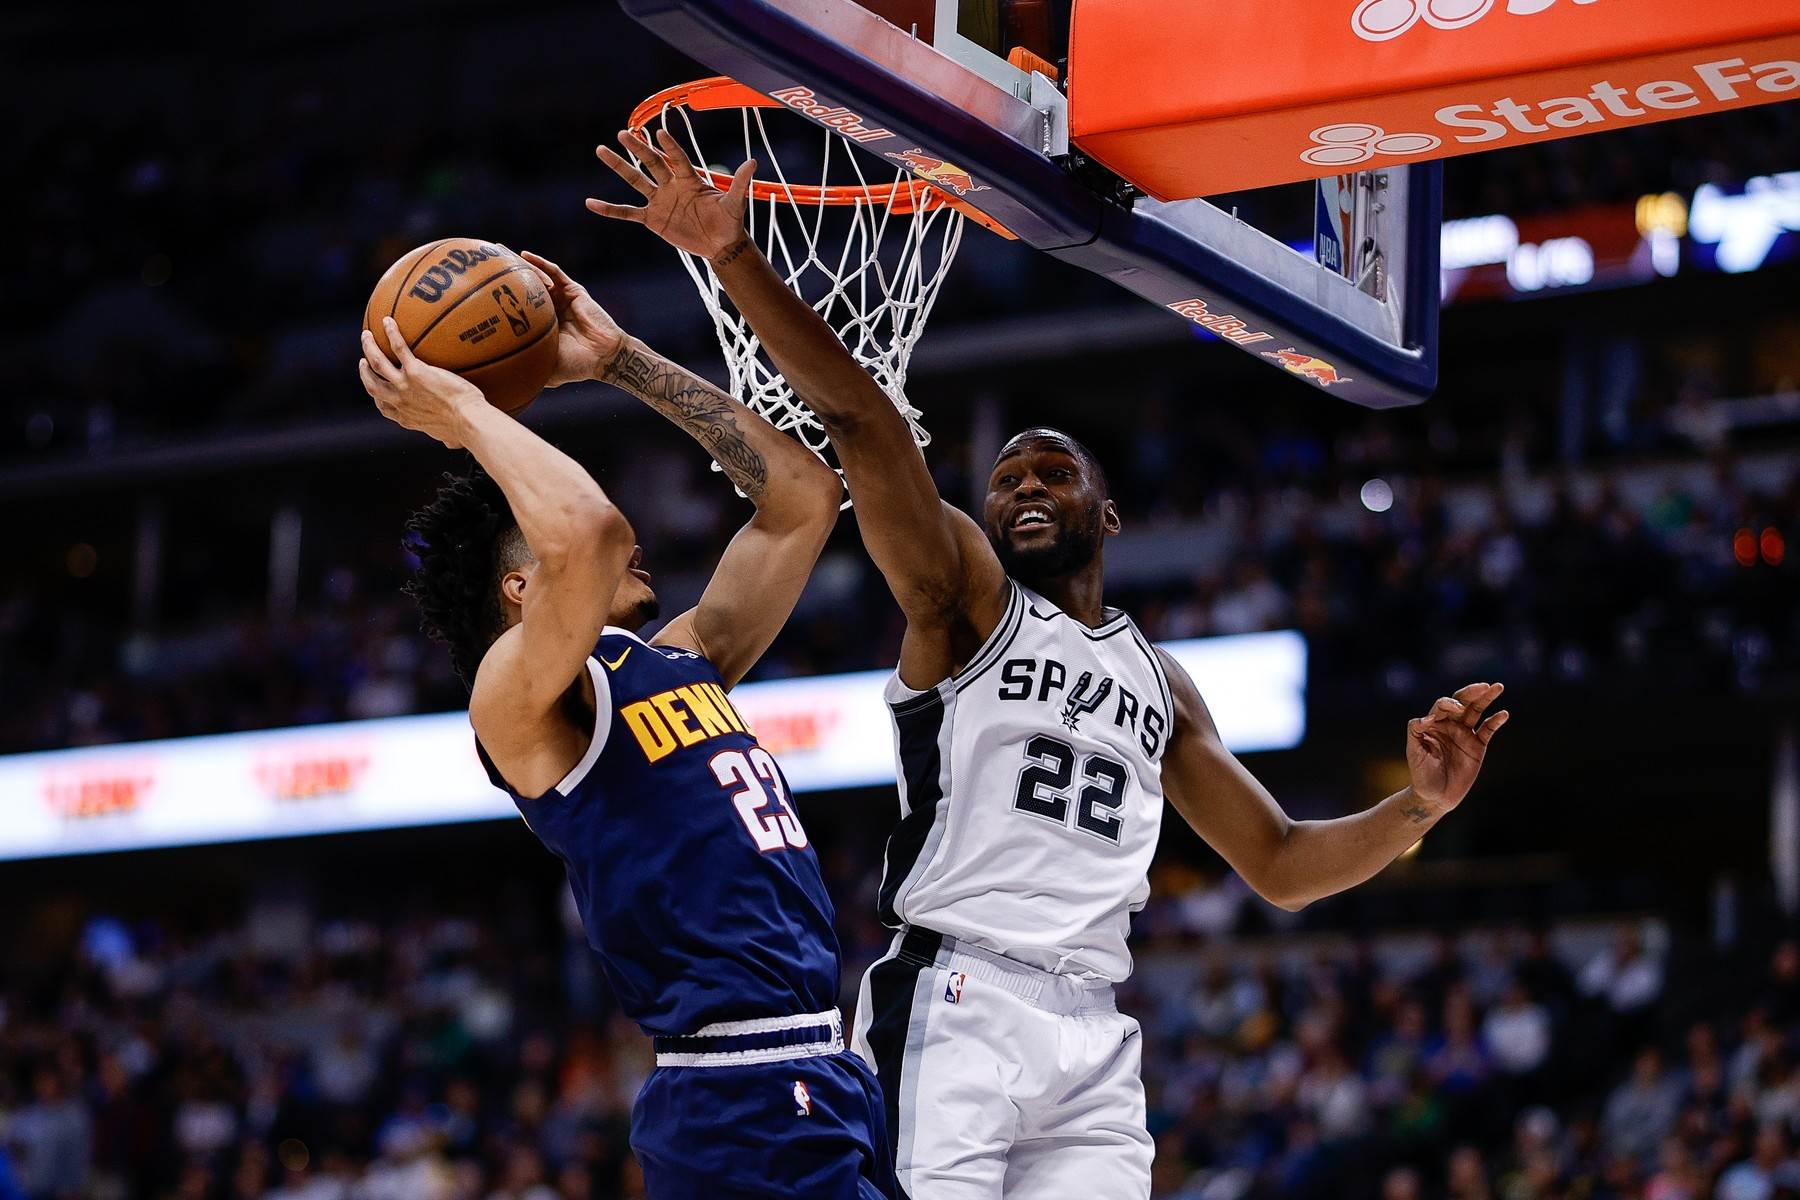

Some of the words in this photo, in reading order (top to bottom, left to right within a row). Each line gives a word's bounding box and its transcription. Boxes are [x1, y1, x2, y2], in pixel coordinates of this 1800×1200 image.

[408, 246, 500, 304] Wilso
[1320, 232, 1337, 266] NBA
[620, 681, 757, 765] DENV
[998, 658, 1165, 760] SPURS
[707, 745, 809, 852] 23
[1010, 732, 1131, 848] 22
